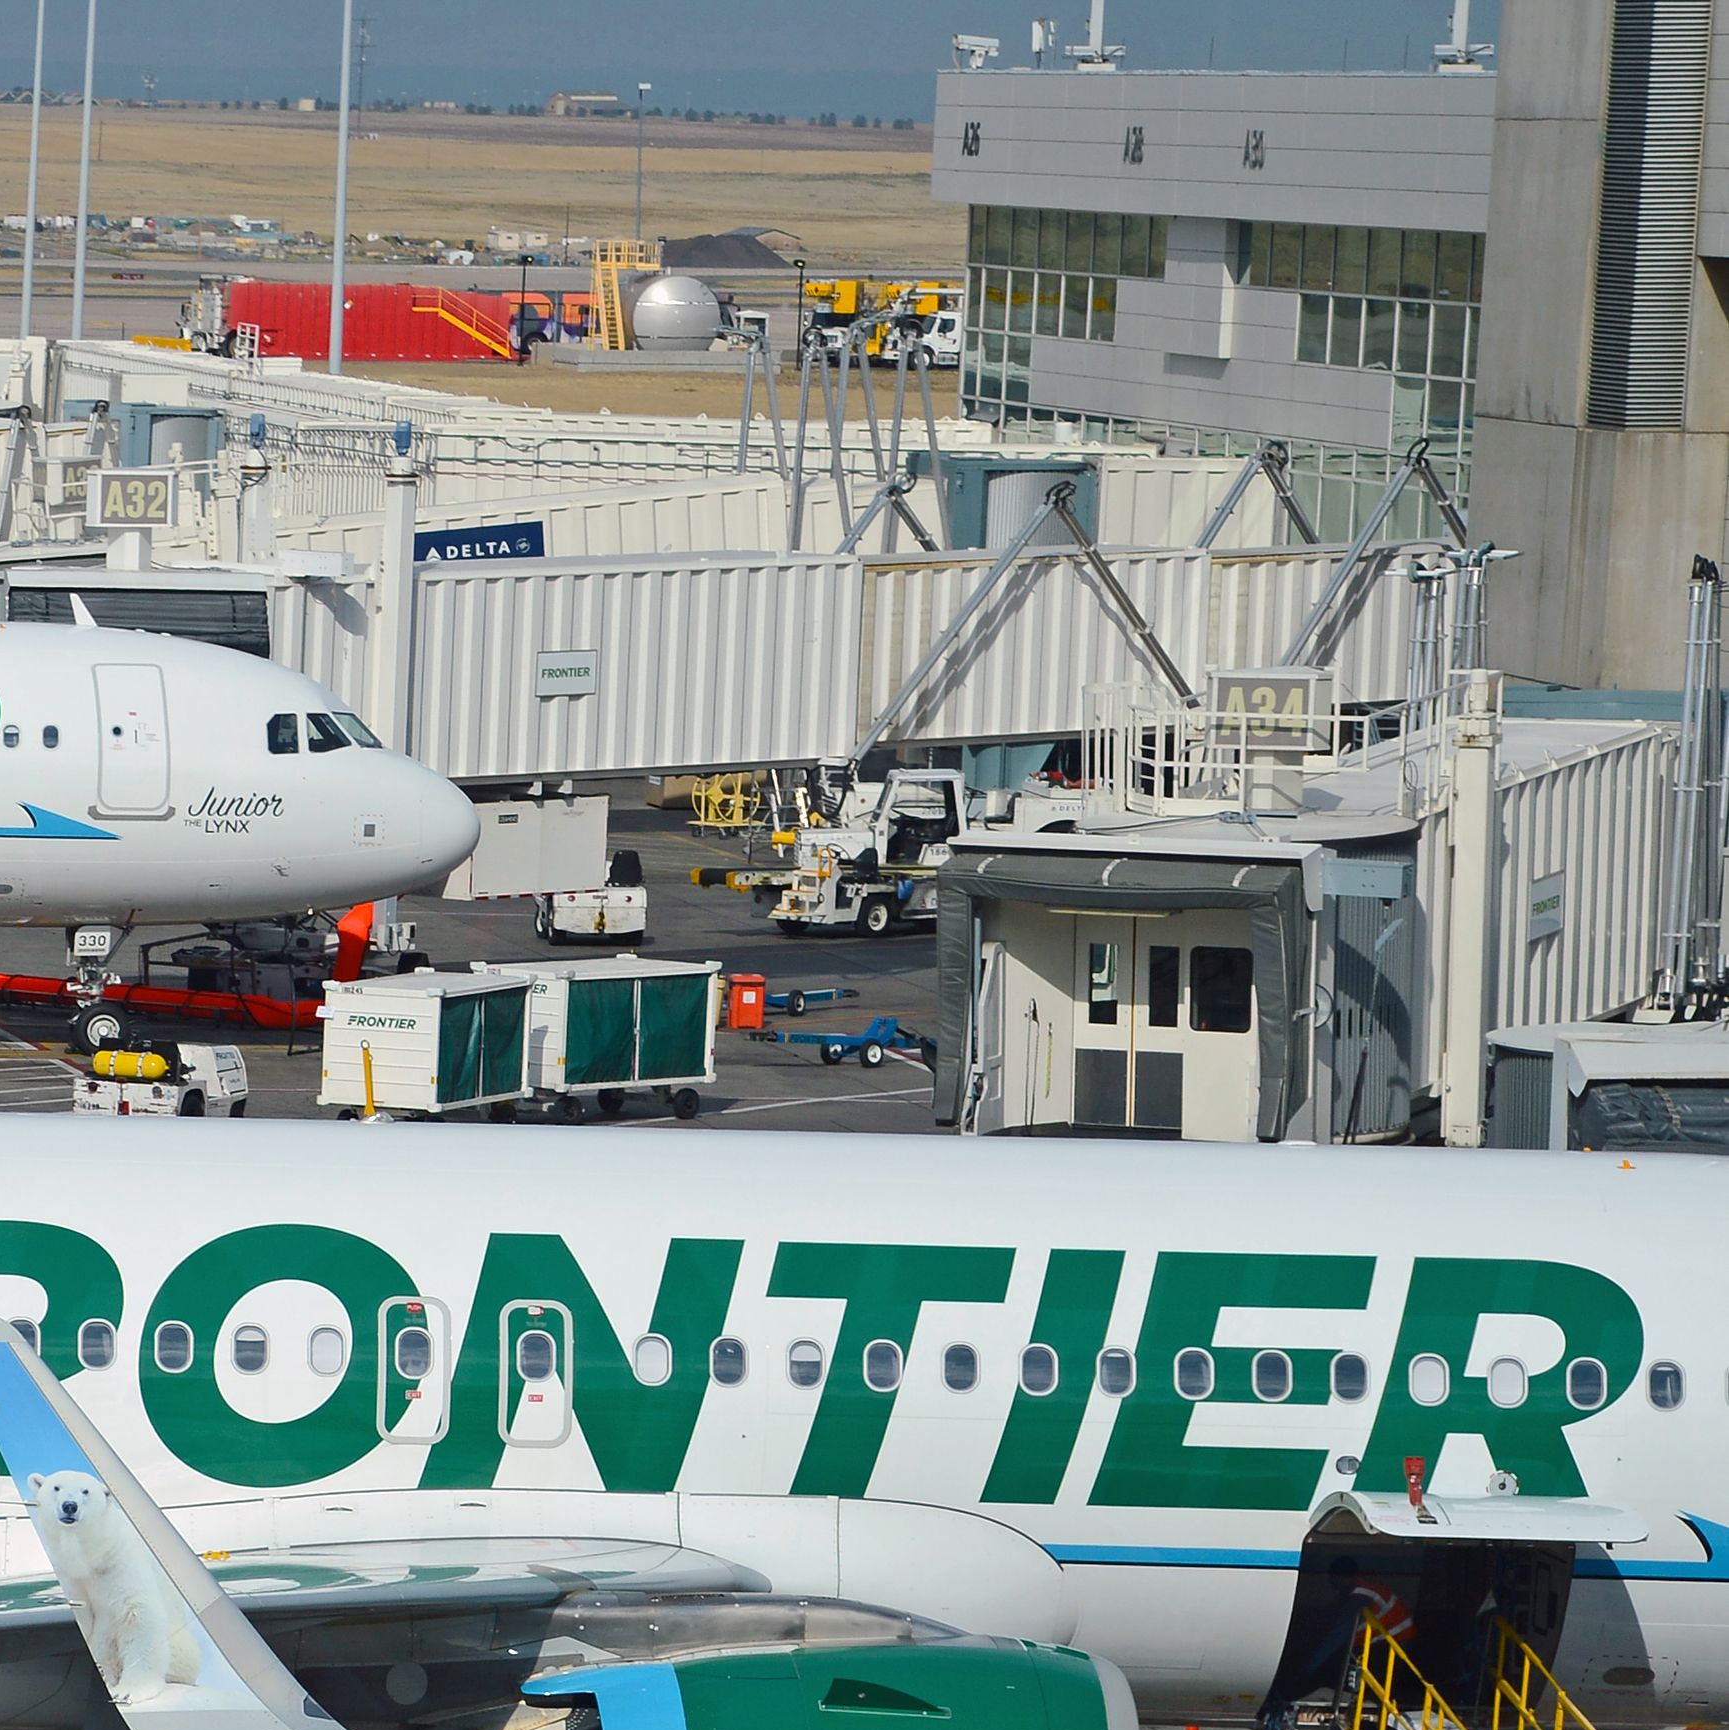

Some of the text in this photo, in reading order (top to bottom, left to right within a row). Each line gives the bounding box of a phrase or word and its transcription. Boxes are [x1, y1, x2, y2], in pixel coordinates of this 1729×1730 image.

[65, 464, 100, 498] A3
[104, 480, 166, 519] A32
[446, 540, 511, 559] DELTA
[541, 666, 591, 679] FRONTIER
[1221, 687, 1307, 737] A34
[188, 786, 284, 817] Junior
[205, 819, 250, 834] LYNX
[79, 935, 107, 947] 330
[348, 1015, 416, 1030] FRONTIER
